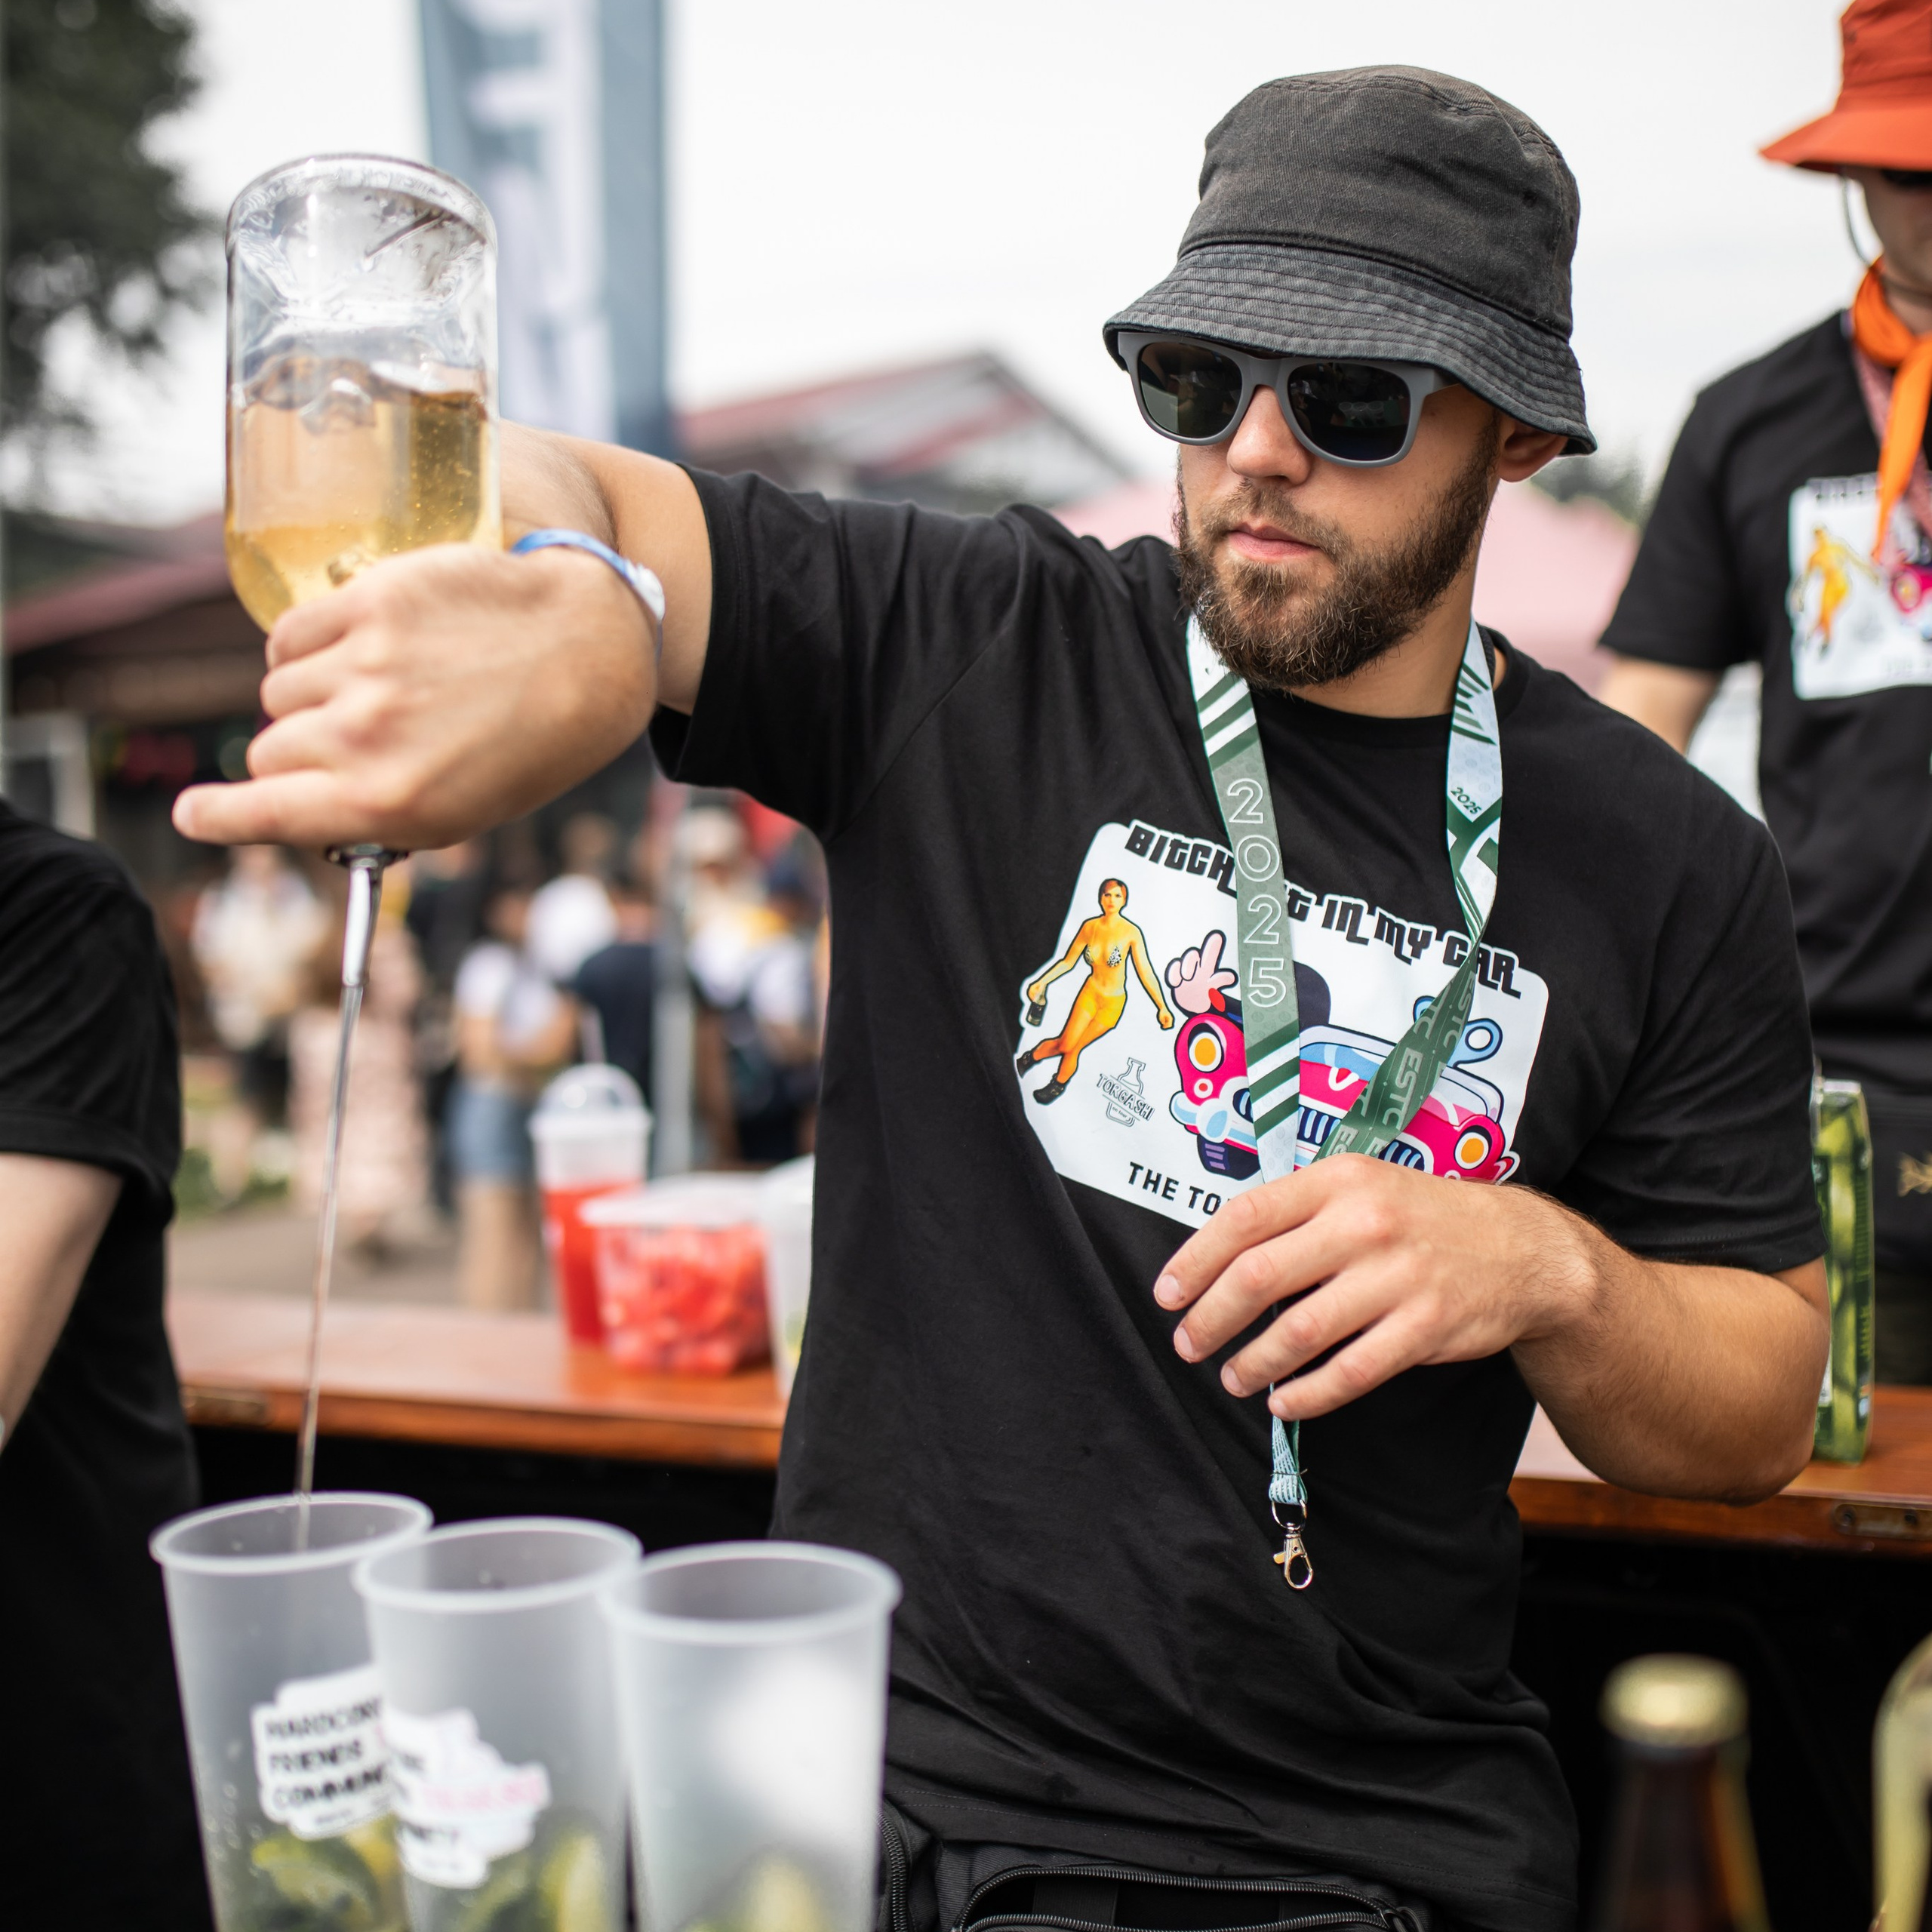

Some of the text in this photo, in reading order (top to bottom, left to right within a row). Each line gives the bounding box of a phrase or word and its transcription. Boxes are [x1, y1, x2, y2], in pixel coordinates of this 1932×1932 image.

[1451, 786, 1482, 814] 2025
[1124, 824, 1238, 899] BITCH
[1321, 898, 1369, 946] IN
[1374, 911, 1434, 966] MY
[1227, 777, 1287, 1008] 2025
[1097, 1073, 1155, 1121] TORGASH
[1382, 1048, 1423, 1131] ESTC
[1128, 1161, 1231, 1217] THE TO
